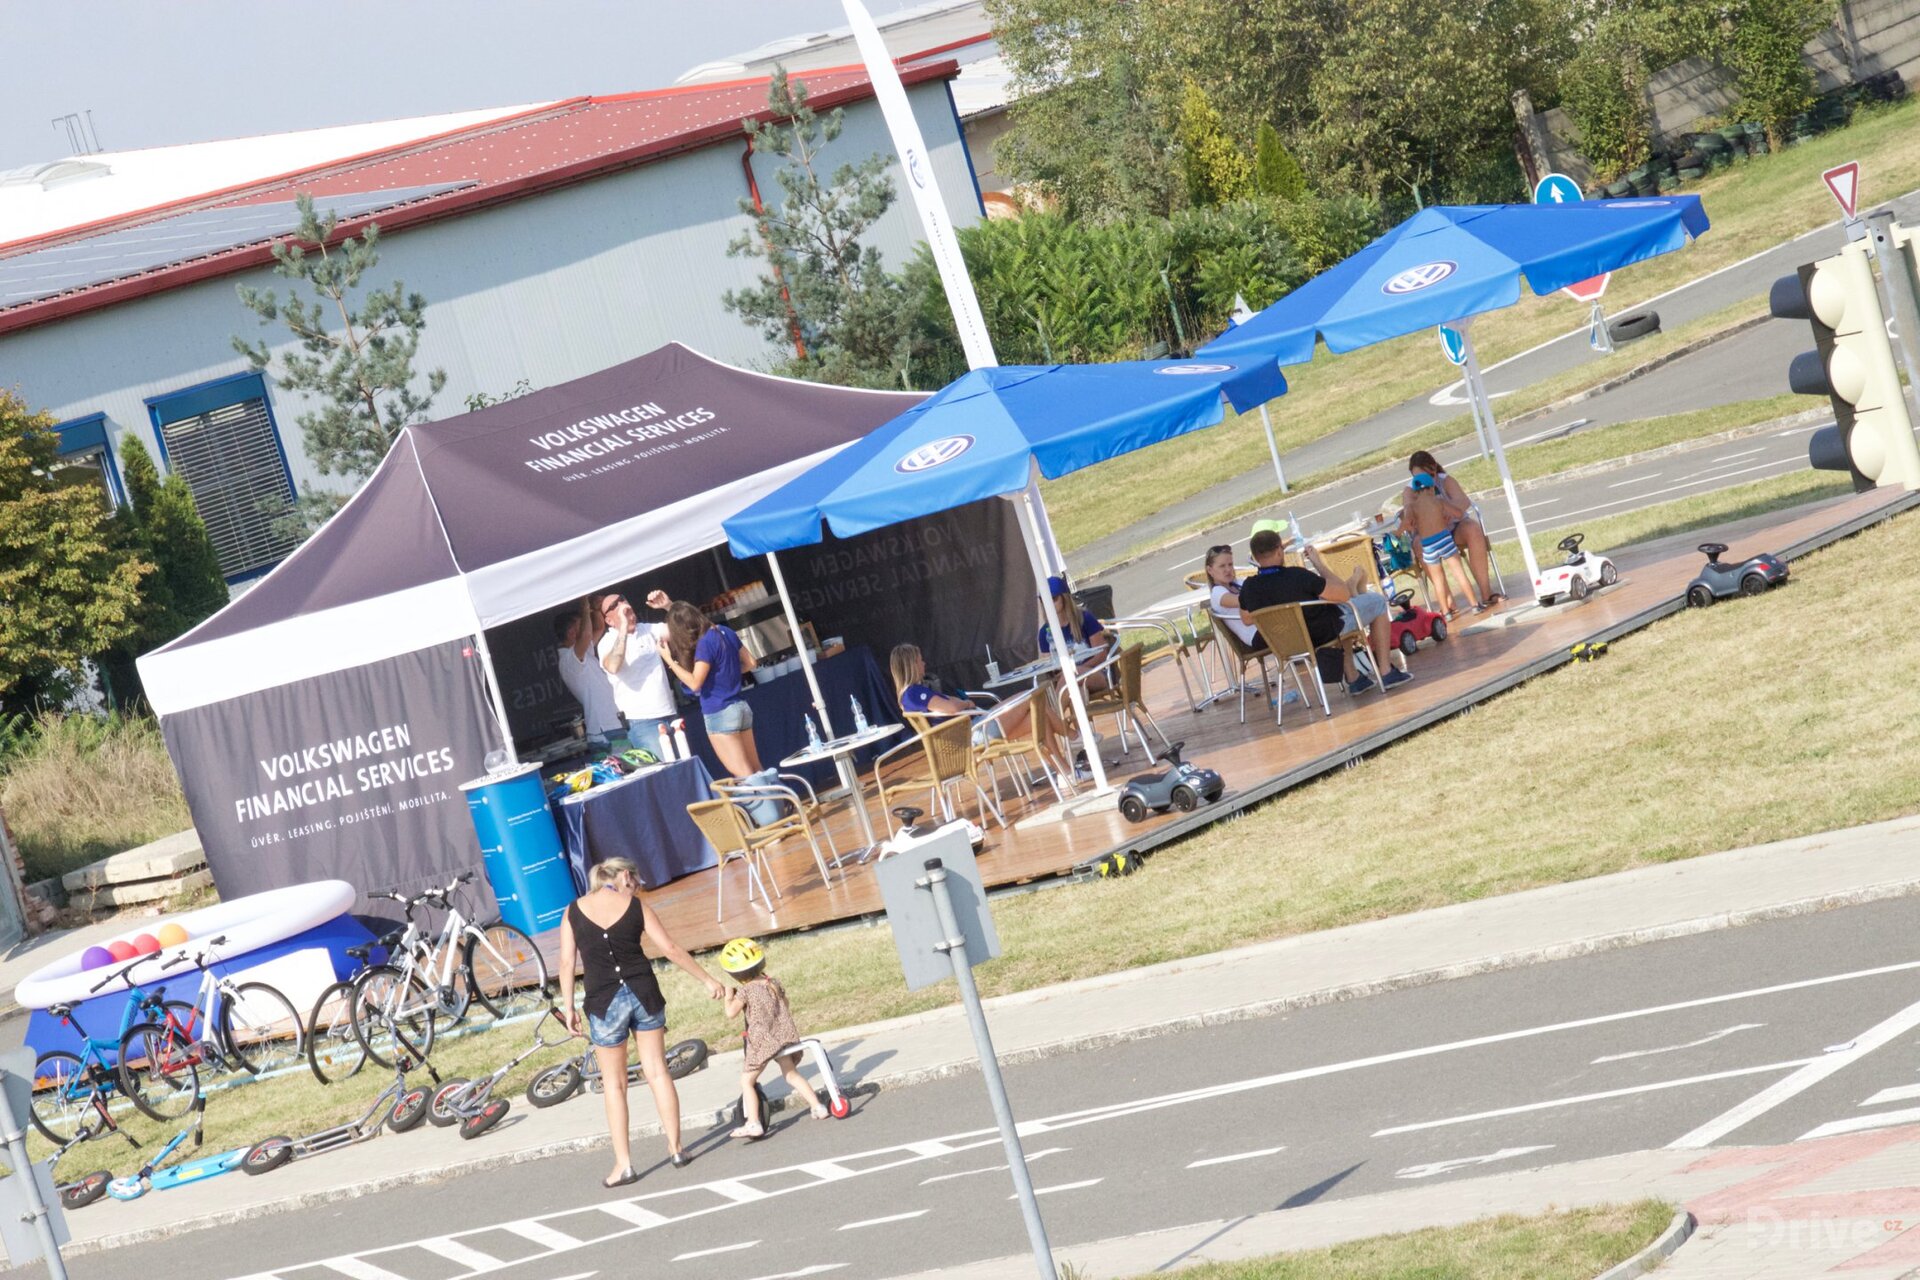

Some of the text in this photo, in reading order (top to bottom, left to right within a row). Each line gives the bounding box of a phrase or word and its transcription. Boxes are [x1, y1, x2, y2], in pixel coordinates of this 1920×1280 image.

[524, 407, 716, 472] FINANCIAL SERVICES
[529, 402, 667, 450] VOLKSWAGEN
[260, 723, 411, 781] VOLKSWAGEN
[235, 747, 454, 823] FINANCIAL SERVICES
[288, 819, 337, 839] LEASING.
[339, 802, 395, 826] POJIŠTĚNÍ.
[399, 790, 452, 811] MOBILITA.
